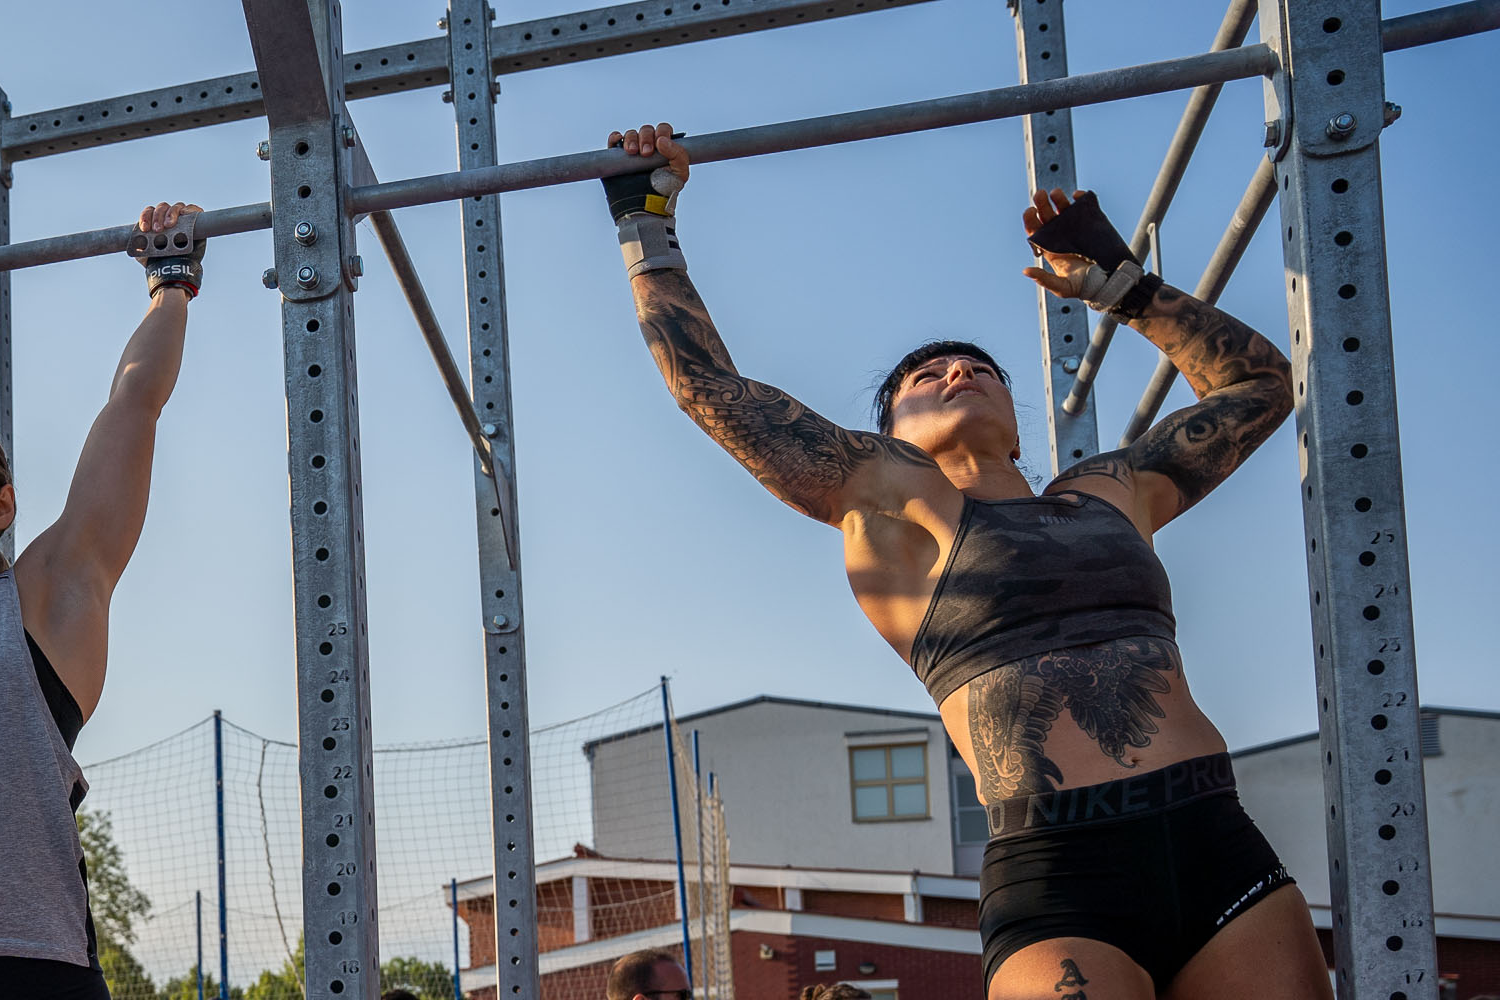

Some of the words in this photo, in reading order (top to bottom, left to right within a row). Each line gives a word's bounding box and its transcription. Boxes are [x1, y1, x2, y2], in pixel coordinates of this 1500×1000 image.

[150, 265, 194, 281] PICSIL
[1369, 530, 1395, 545] 25
[1373, 584, 1400, 598] 24
[328, 623, 347, 636] 25
[1378, 638, 1402, 653] 23
[329, 670, 349, 684] 24
[1381, 693, 1408, 708] 22
[331, 718, 350, 731] 23
[1385, 748, 1410, 763] 21
[333, 766, 353, 780] 22
[1023, 778, 1149, 828] NIKE
[1389, 802, 1417, 818] 20
[334, 814, 352, 828] 21
[336, 862, 356, 876] 20
[338, 911, 358, 925] 19
[1399, 913, 1424, 928] 18
[341, 960, 359, 974] 18
[1403, 969, 1426, 984] 17
